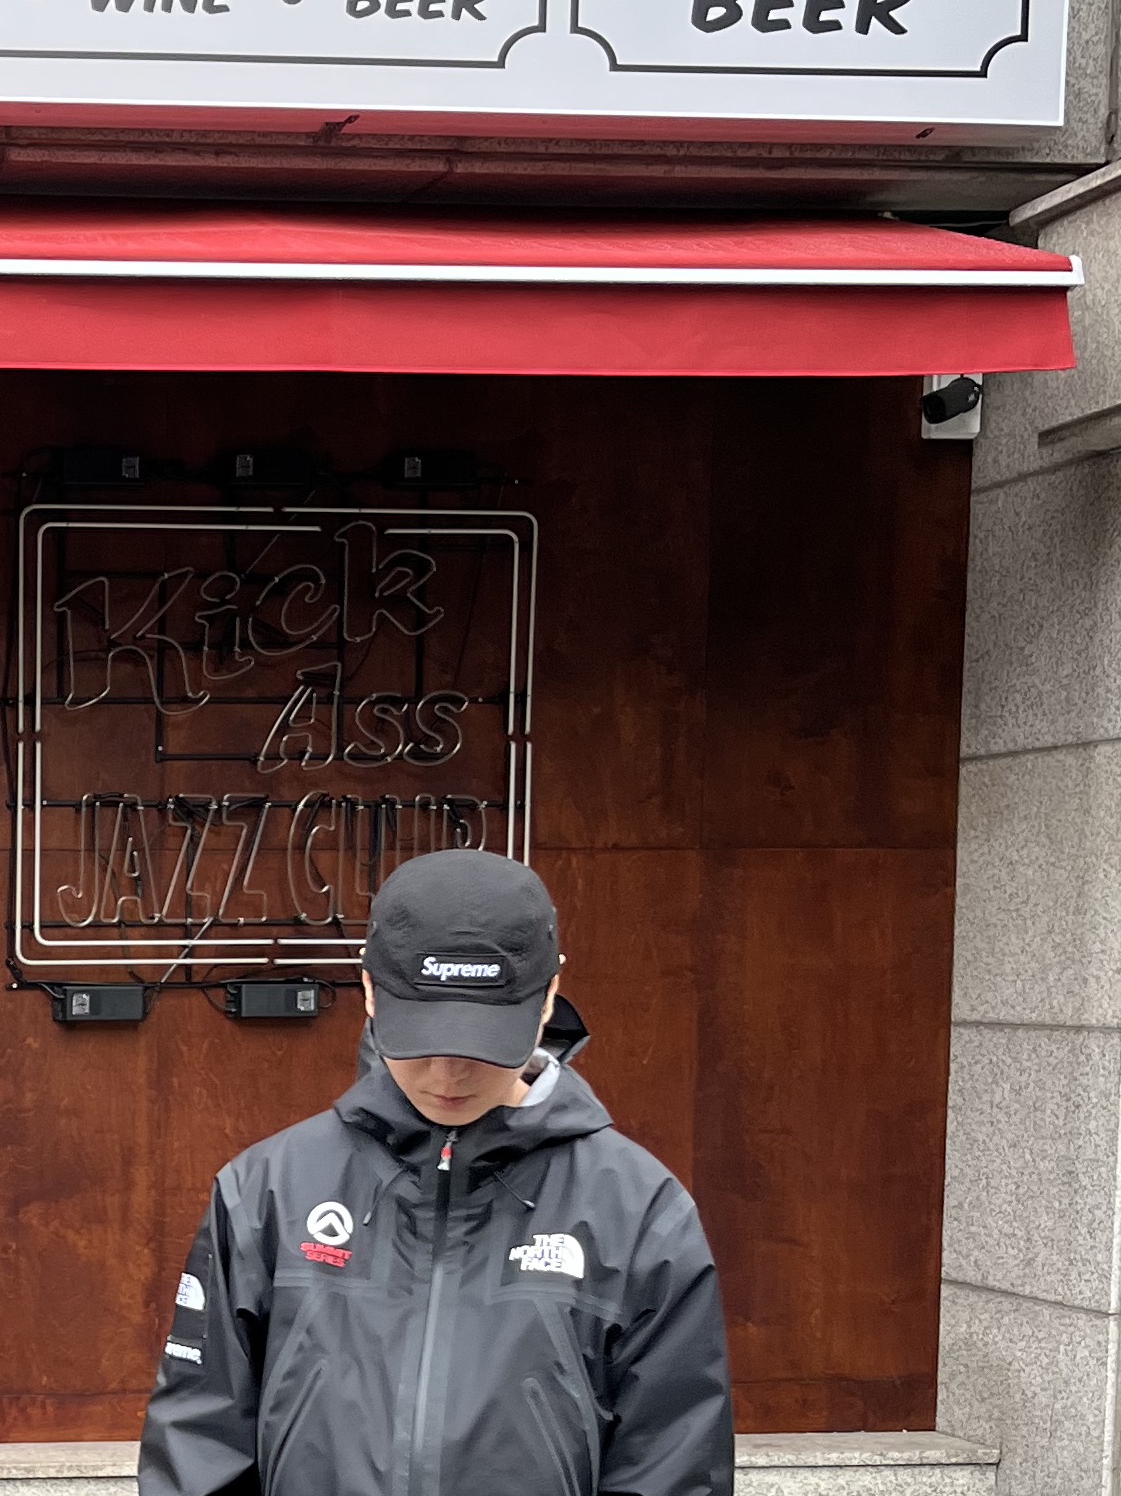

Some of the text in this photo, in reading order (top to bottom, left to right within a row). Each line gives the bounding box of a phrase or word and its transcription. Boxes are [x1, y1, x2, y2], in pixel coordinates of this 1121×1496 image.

[54, 521, 445, 715] Kick
[258, 662, 469, 774] Ass
[57, 793, 267, 927] JAZZ
[421, 956, 501, 981] Supreme
[532, 1233, 564, 1247] THE
[300, 1241, 353, 1260] SUMMIT
[305, 1250, 346, 1268] SERIES
[508, 1245, 561, 1261] NORTH
[520, 1259, 563, 1272] FACE
